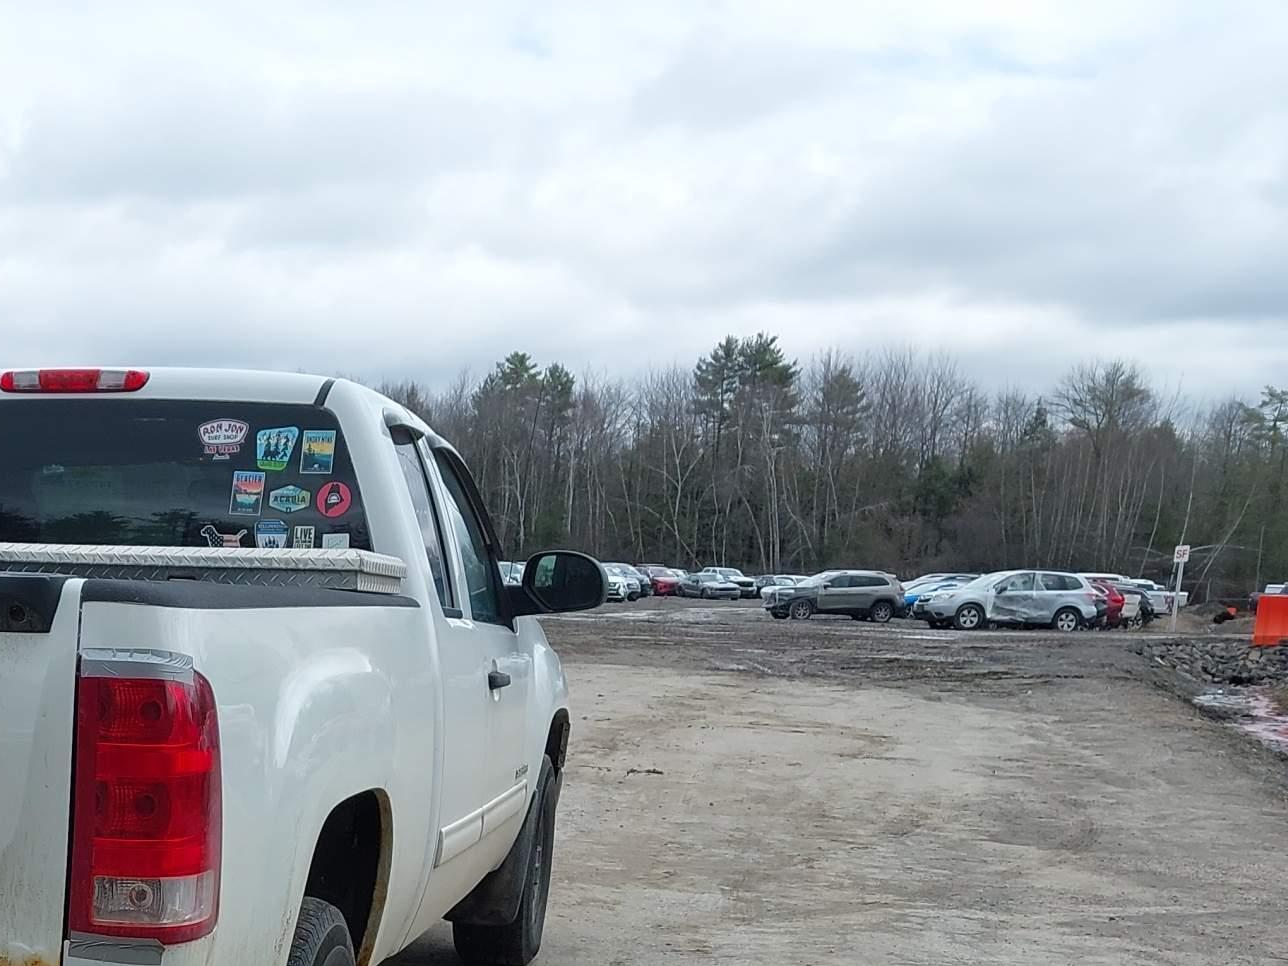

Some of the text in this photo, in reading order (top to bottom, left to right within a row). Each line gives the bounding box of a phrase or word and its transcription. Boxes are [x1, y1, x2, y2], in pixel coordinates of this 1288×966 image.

[203, 423, 244, 437] RON JON
[223, 433, 239, 441] SHOP
[272, 495, 306, 505] ACADIA
[295, 527, 313, 540] LIVE
[1175, 549, 1189, 559] SF
